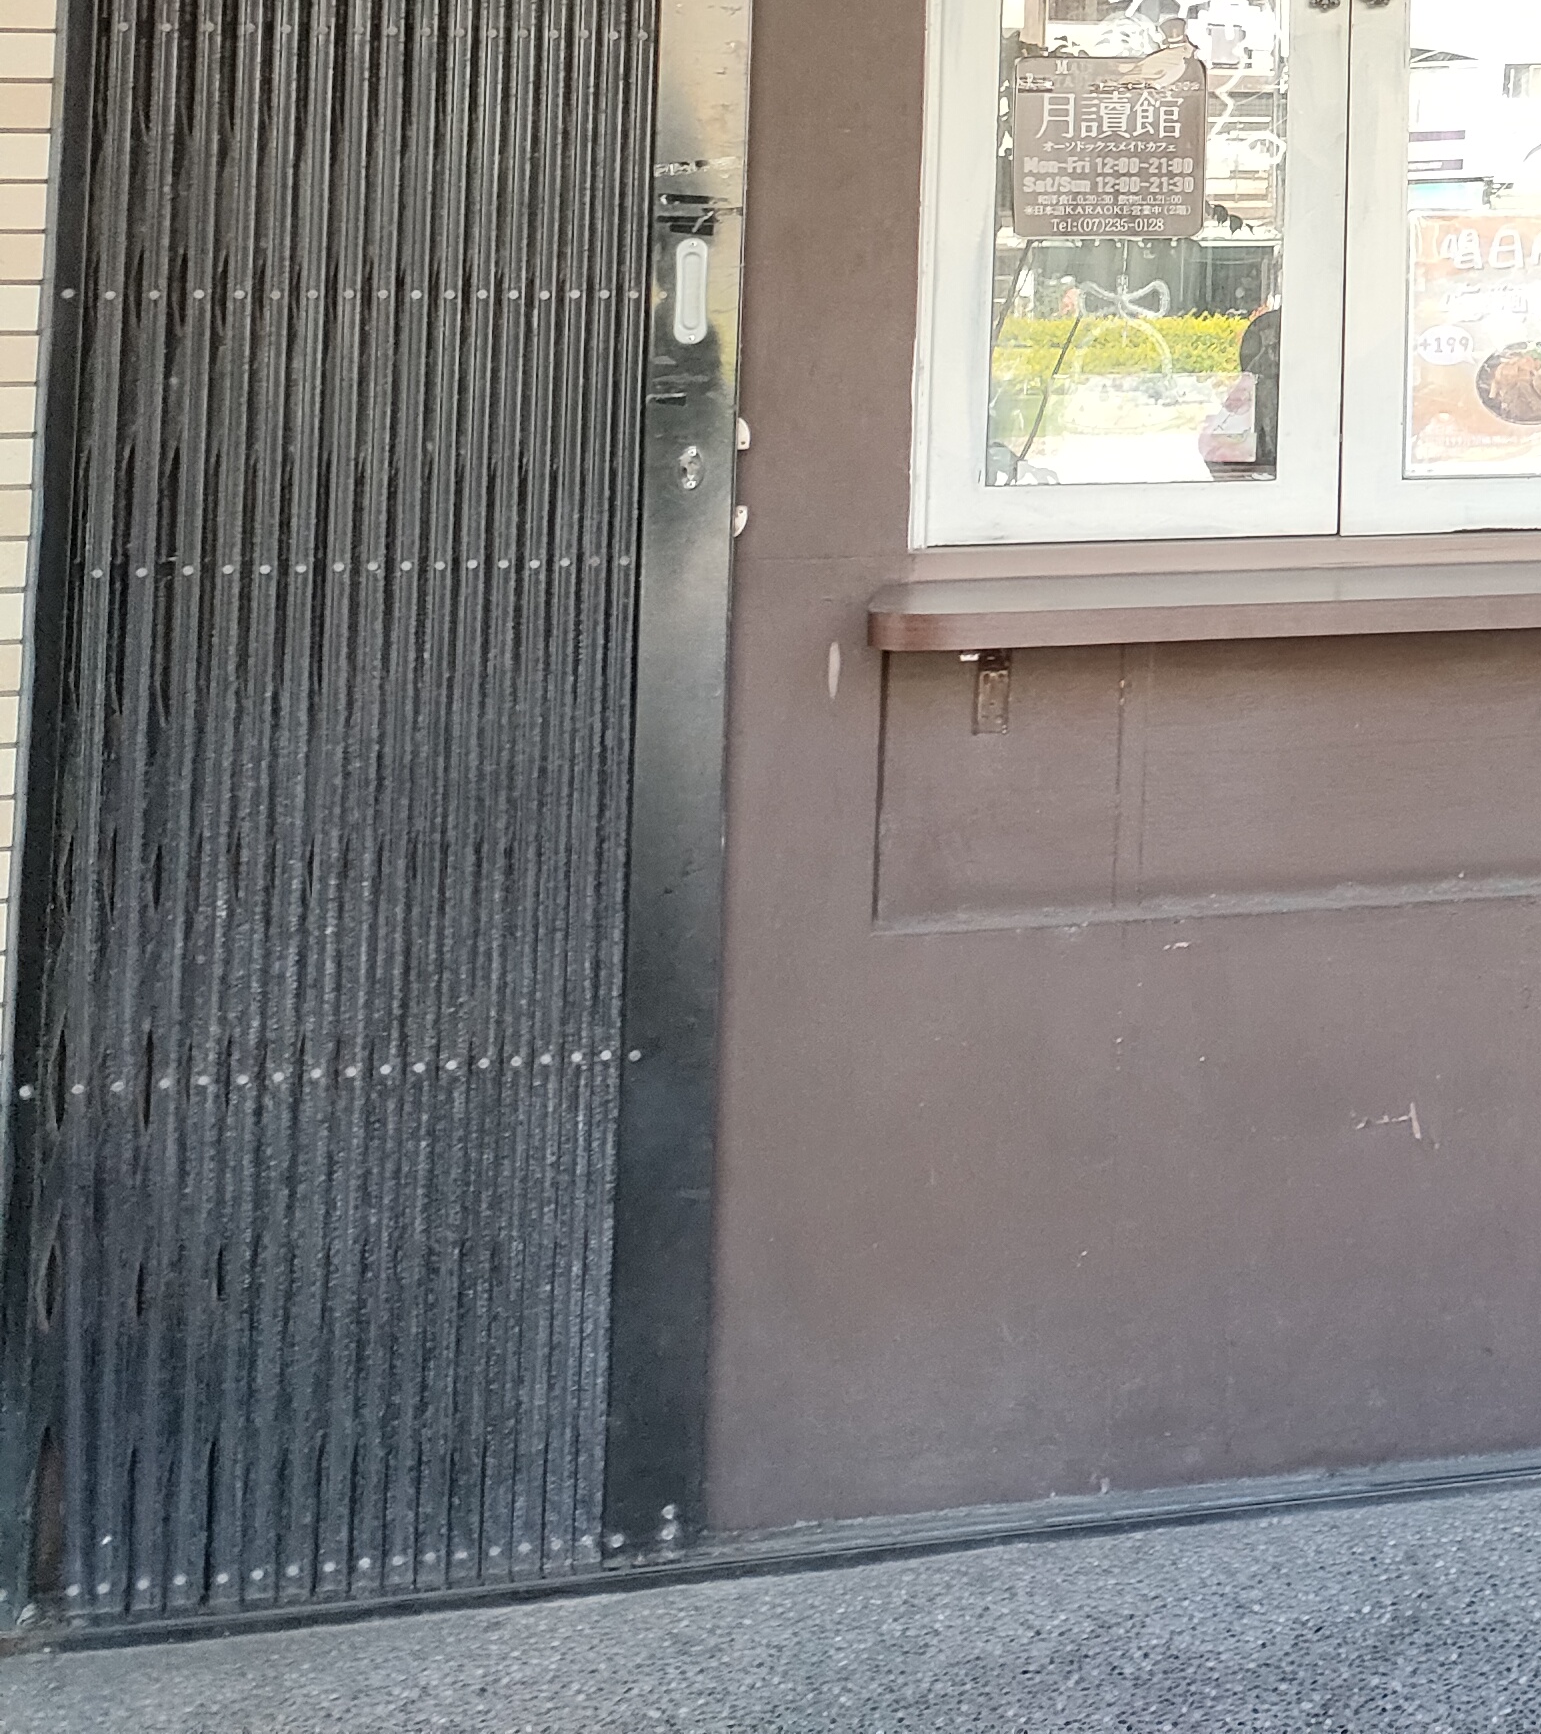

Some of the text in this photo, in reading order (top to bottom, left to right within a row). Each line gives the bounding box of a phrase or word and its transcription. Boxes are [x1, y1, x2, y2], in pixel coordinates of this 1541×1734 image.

[1036, 90, 1185, 139] 月讀館
[1023, 157, 1193, 174] Mon-Fri 12:00-21:00
[1022, 176, 1194, 194] Sat/Sun 12:00-21:30
[1418, 335, 1470, 354] +199
